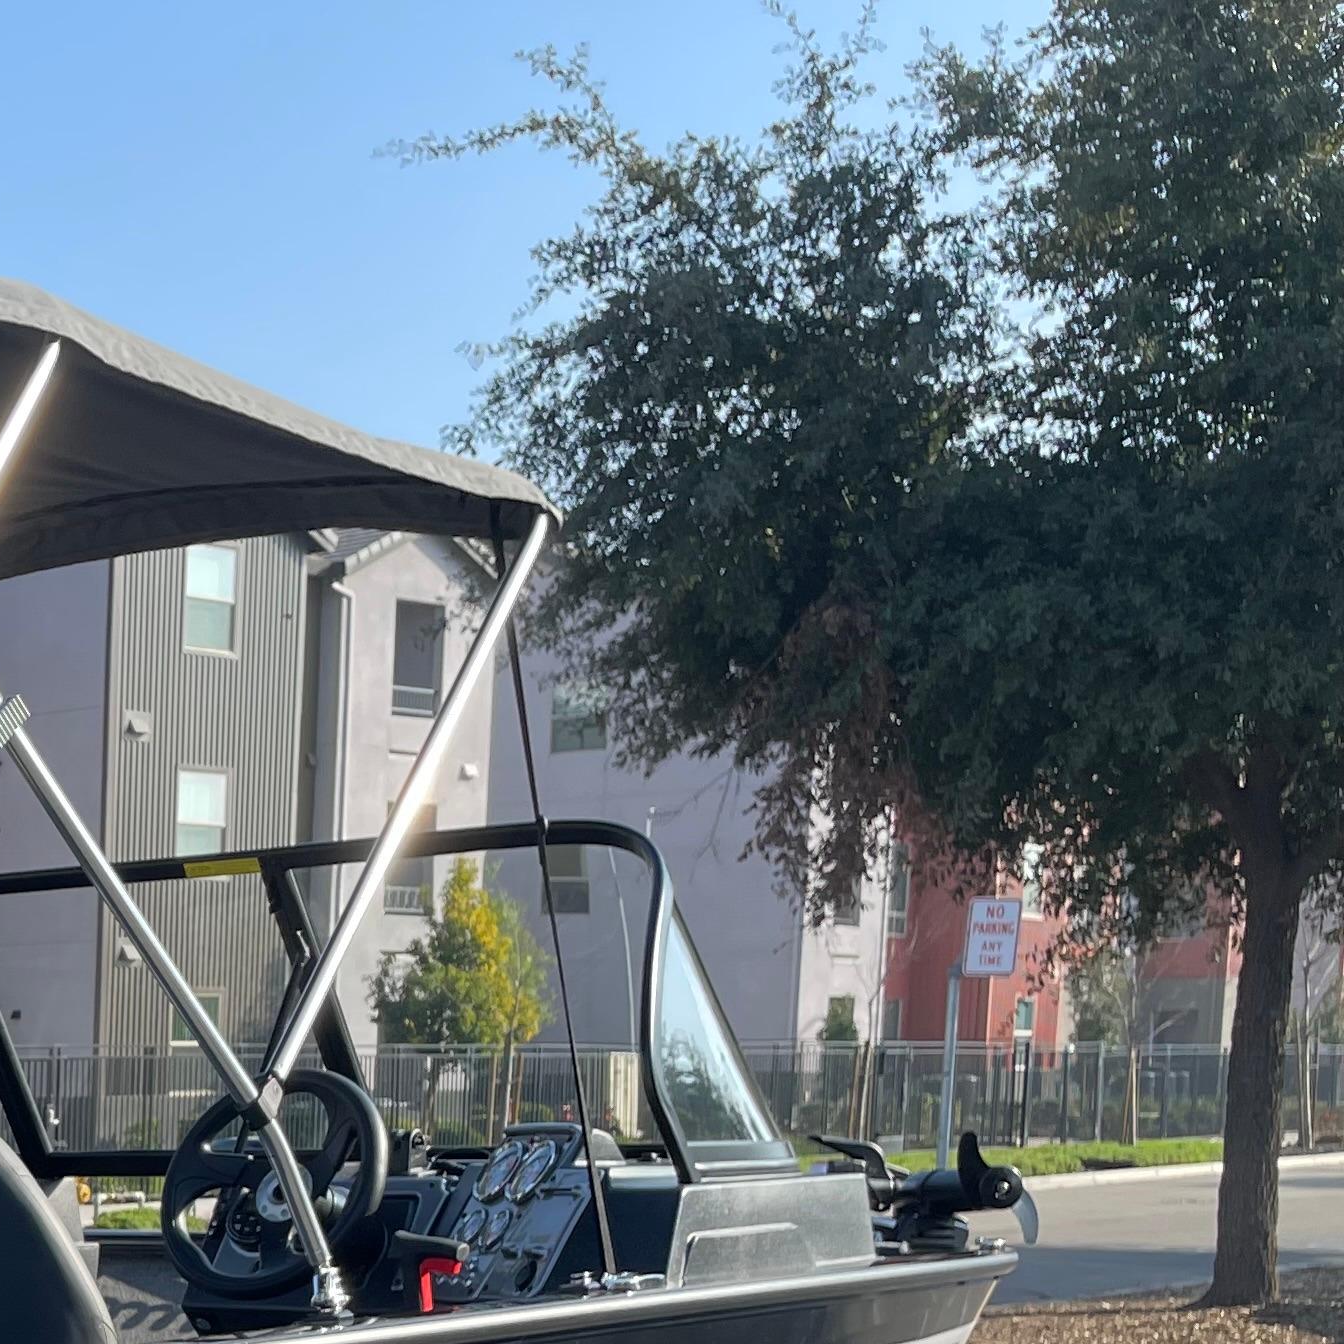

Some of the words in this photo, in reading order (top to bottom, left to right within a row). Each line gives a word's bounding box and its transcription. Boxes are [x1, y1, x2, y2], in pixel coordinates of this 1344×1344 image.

[986, 904, 1005, 918] NO
[973, 921, 1015, 935] PARKING
[982, 941, 1003, 952] ANY
[979, 954, 1002, 966] TIME
